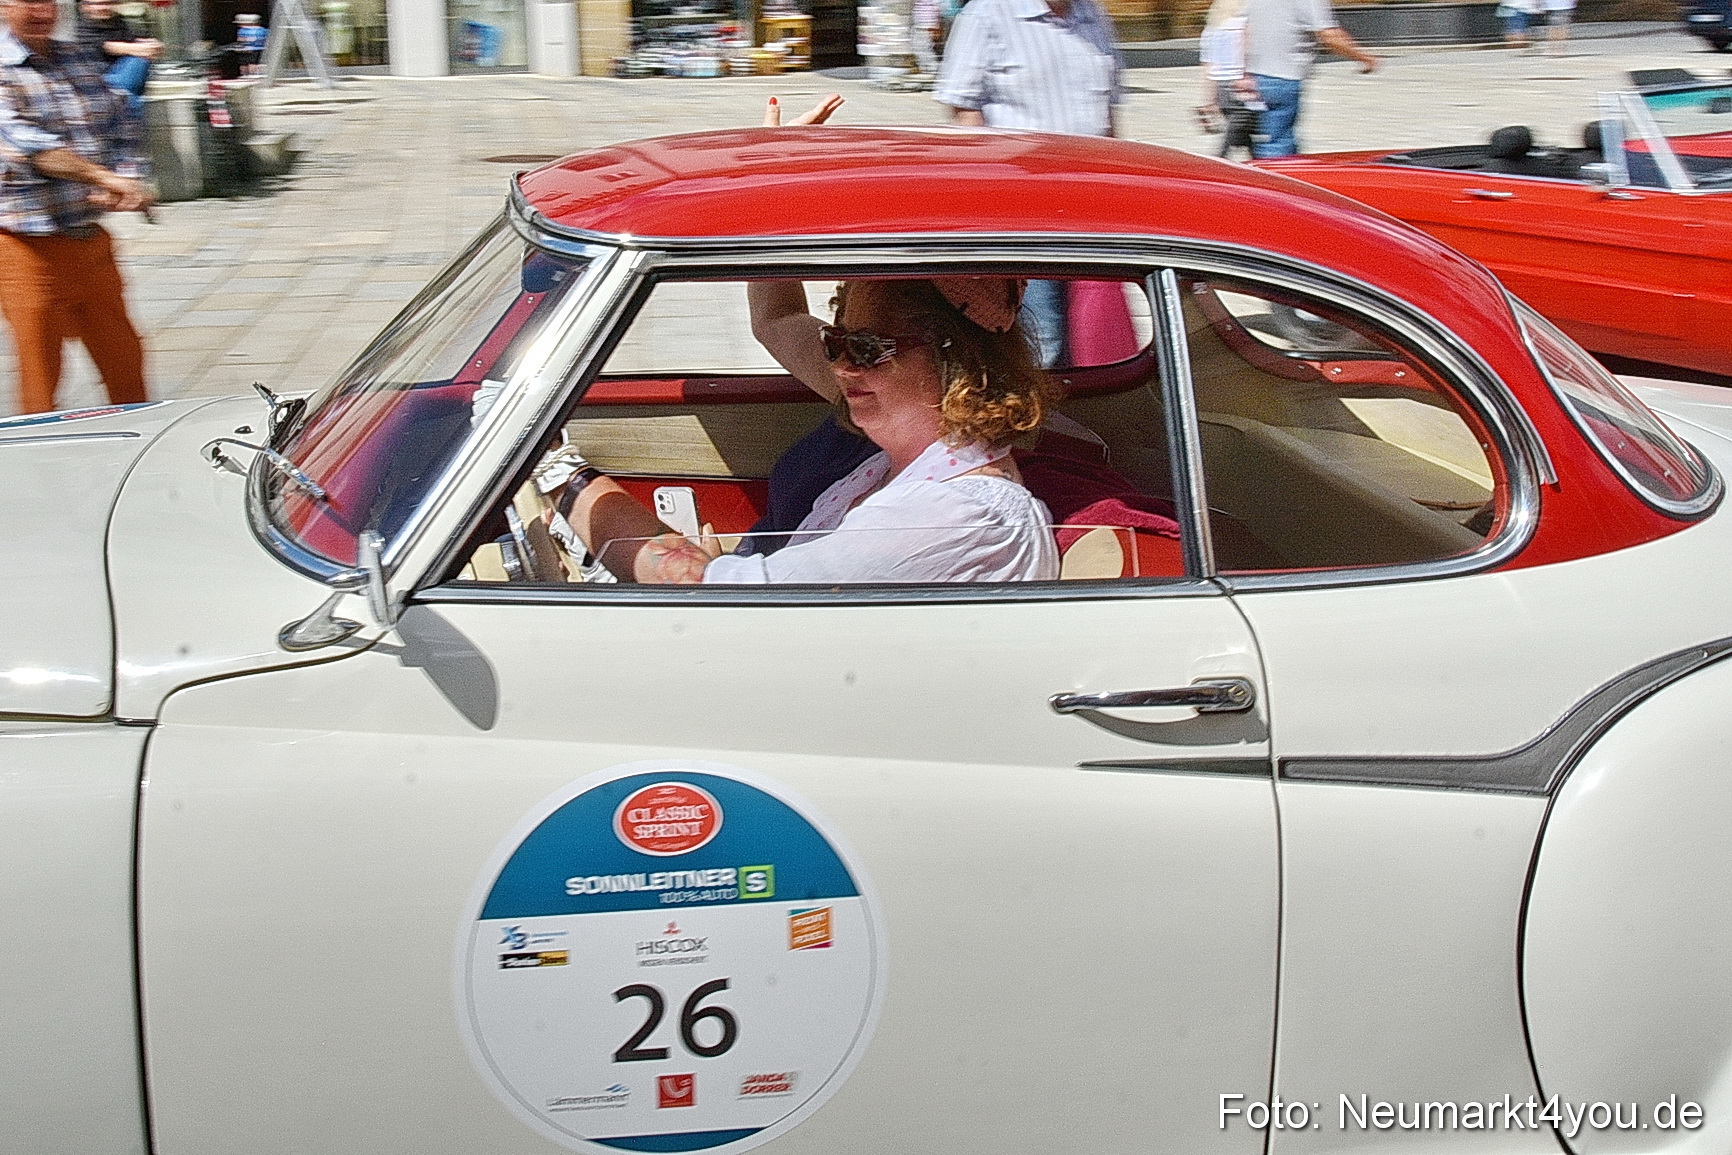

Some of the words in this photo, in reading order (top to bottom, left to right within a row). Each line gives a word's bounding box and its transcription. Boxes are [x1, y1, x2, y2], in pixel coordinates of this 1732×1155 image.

[626, 804, 710, 823] CLASSIC
[632, 821, 704, 840] SPRINT
[565, 867, 738, 896] SONNLEITNER
[745, 872, 768, 892] S
[611, 977, 738, 1063] 26
